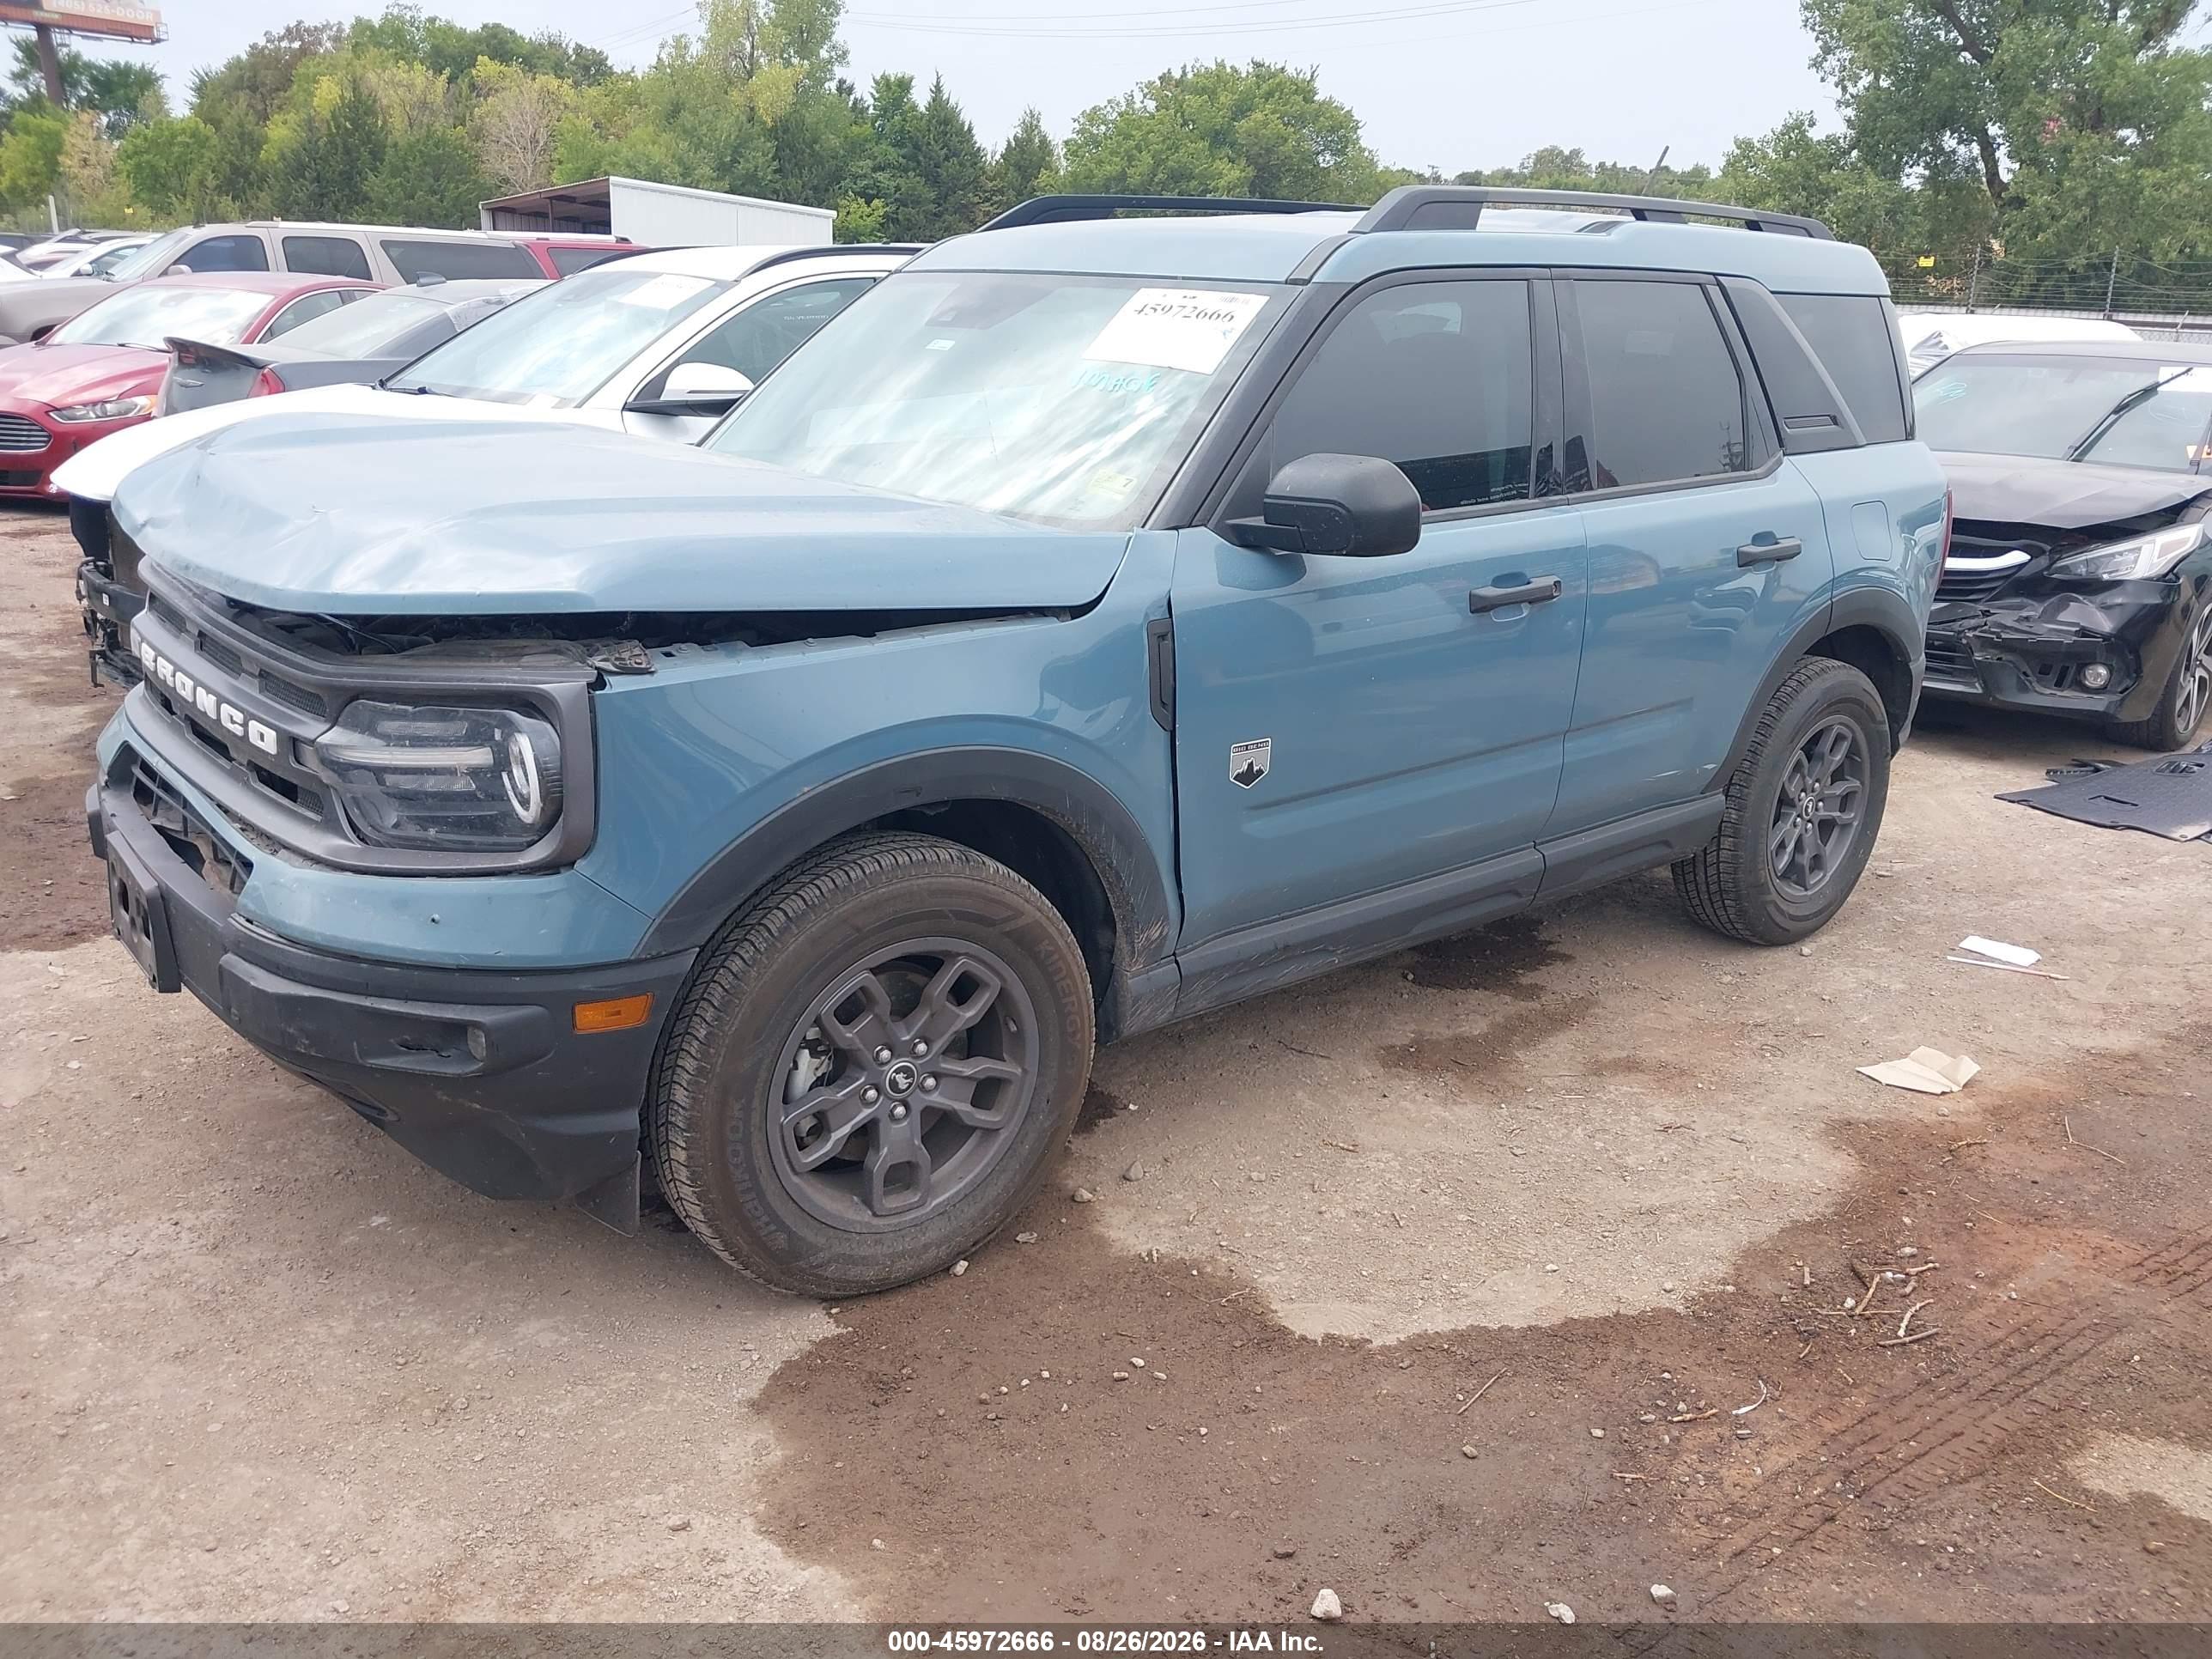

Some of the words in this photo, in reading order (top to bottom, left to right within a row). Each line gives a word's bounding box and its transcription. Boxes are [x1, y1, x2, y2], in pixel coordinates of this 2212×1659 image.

[1133, 302, 1235, 323] 45972666
[141, 642, 277, 755] BRONCO
[1248, 741, 1269, 750] BEND
